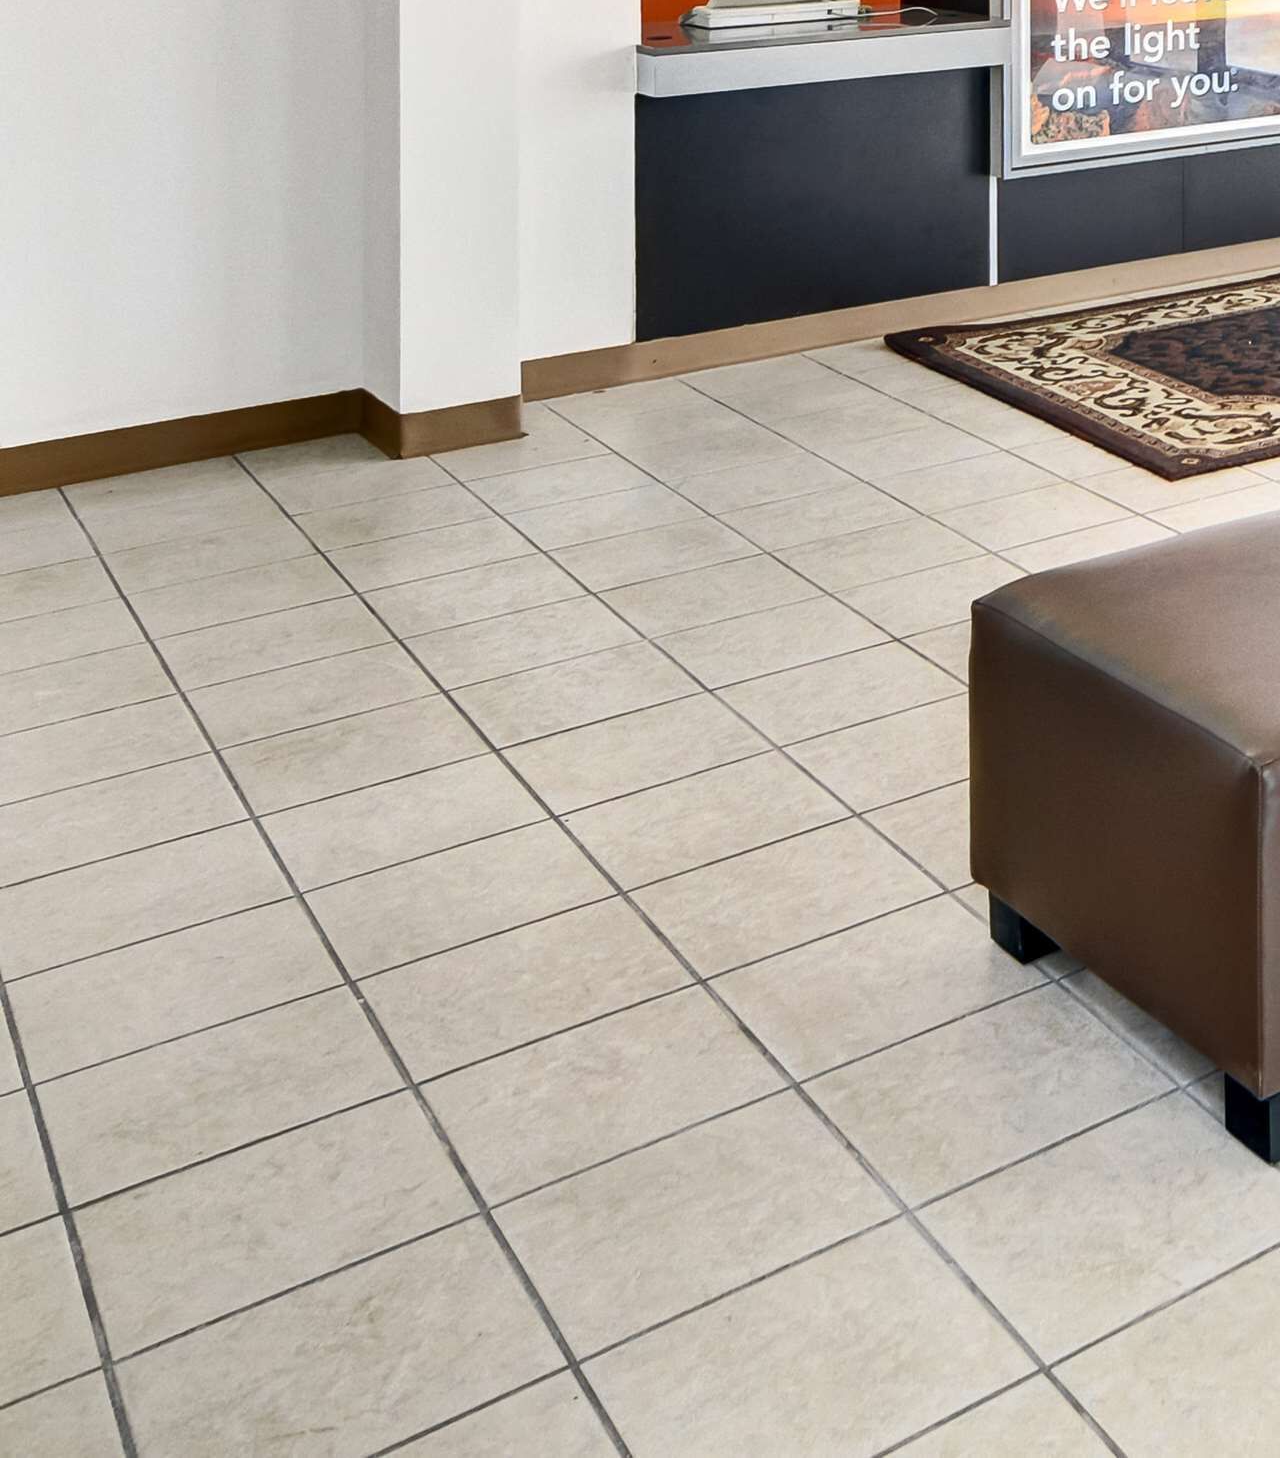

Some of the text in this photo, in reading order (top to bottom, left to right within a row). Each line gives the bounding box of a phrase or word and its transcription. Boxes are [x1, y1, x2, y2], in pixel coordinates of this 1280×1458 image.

[1051, 20, 1201, 63] the light
[1052, 85, 1097, 112] on
[1109, 70, 1160, 105] for
